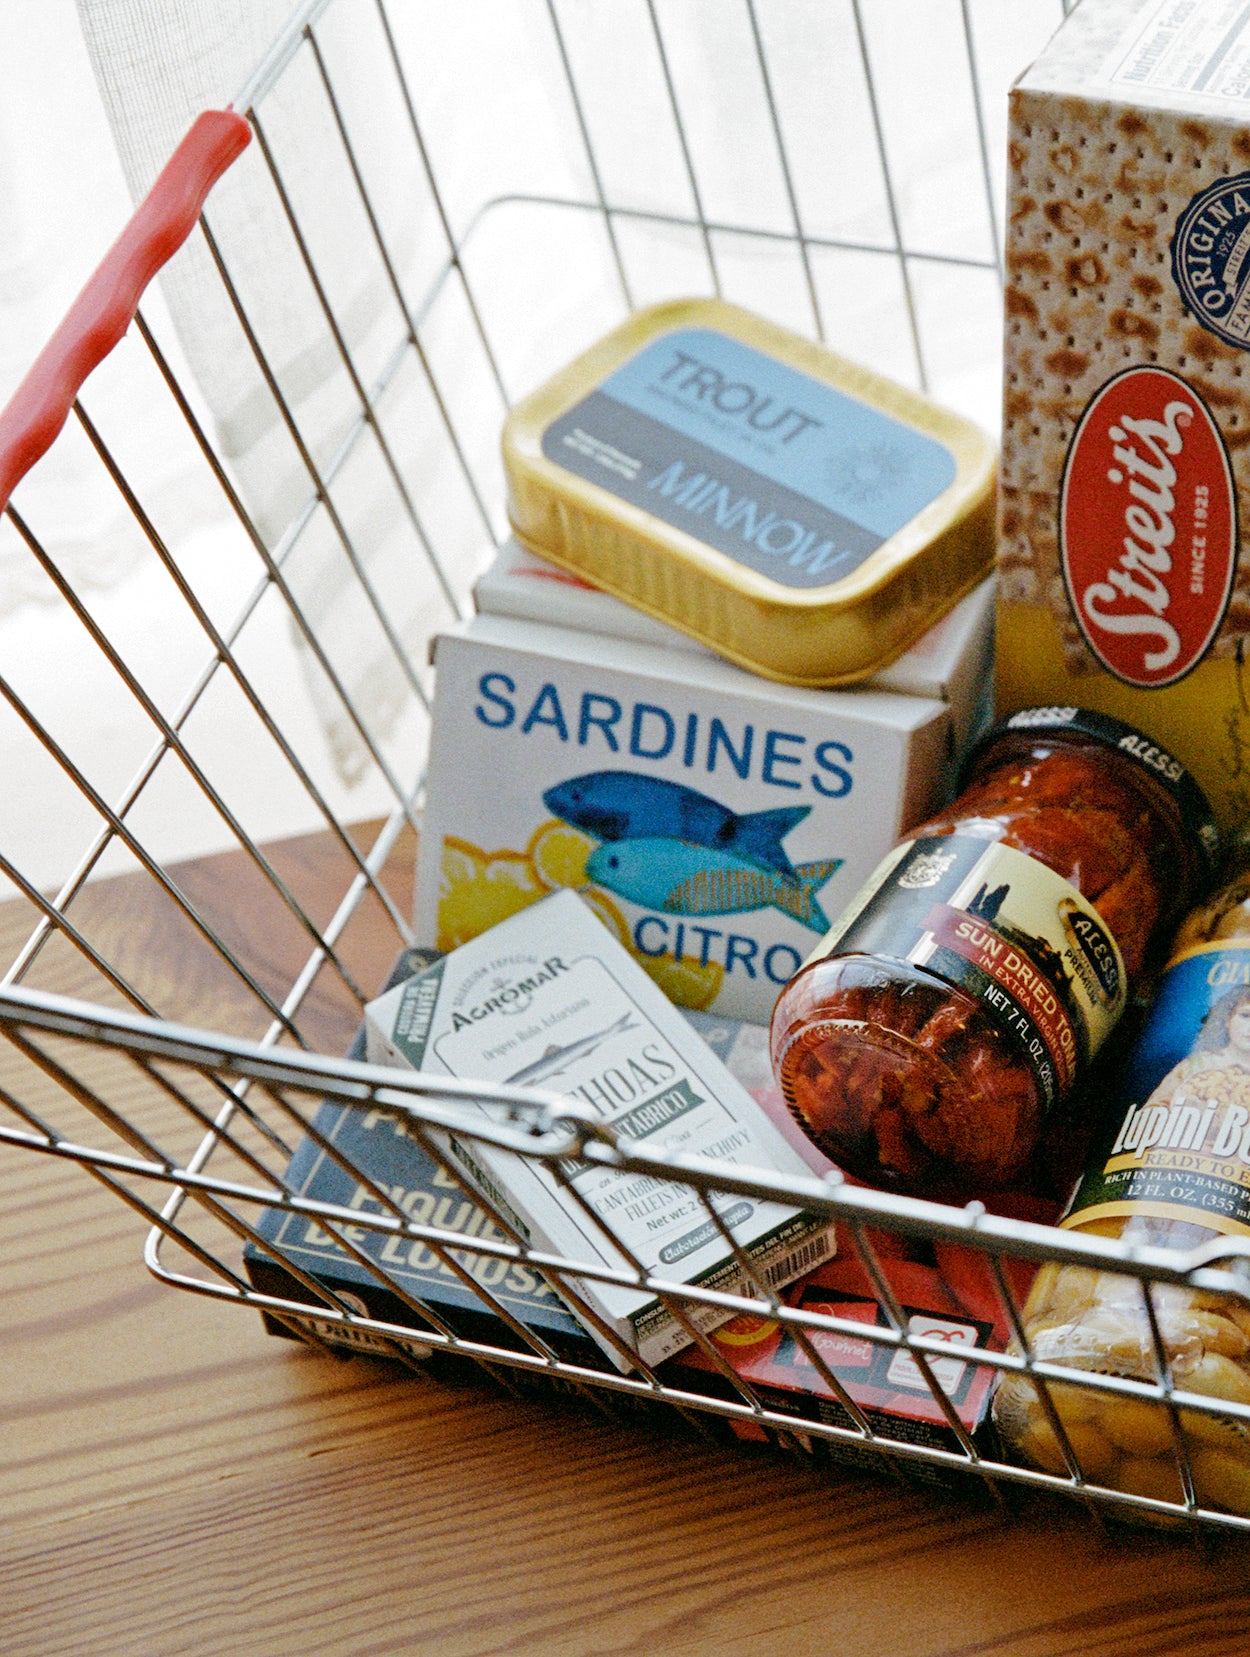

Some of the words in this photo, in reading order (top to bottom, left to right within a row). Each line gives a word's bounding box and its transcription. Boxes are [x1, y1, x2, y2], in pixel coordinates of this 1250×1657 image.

[1216, 230, 1237, 258] 1925
[661, 351, 824, 445] TROUT
[647, 459, 850, 576] MINNOW
[1083, 400, 1195, 671] Streit's
[1190, 536, 1206, 595] SINCE
[475, 671, 856, 800] SARDINES
[1118, 734, 1185, 783] ALESSI
[633, 916, 802, 988] CITRO
[954, 921, 1004, 957] SUN
[1002, 952, 1058, 1016] DRIED
[1206, 959, 1250, 987] GIA
[451, 956, 571, 1033] AGROMAR
[978, 954, 995, 970] IN
[995, 968, 1031, 1007] EXTRA
[1031, 1005, 1058, 1050] VIRGIN
[983, 984, 1012, 1013] NET
[1007, 1007, 1020, 1021] 7
[1015, 1017, 1030, 1044] FL.
[1028, 1038, 1045, 1065] OZ.
[568, 1043, 677, 1127] HOAS
[698, 1128, 751, 1161] NCHOVY
[1110, 1096, 1219, 1160] Lupini
[1104, 1171, 1133, 1185] RICH
[1132, 1170, 1148, 1181] IN
[1148, 1170, 1240, 1197] PLANT-BASED
[1126, 1183, 1143, 1197] 12
[1144, 1184, 1166, 1197] FL.
[1169, 1185, 1198, 1203] OZ.
[1201, 1191, 1235, 1213] (355
[1144, 1153, 1208, 1170] READY
[1209, 1161, 1236, 1179] TO
[624, 1189, 674, 1222] FILLETS
[646, 1216, 669, 1232] Net
[668, 1206, 690, 1220] wt:
[688, 1200, 698, 1212] 2
